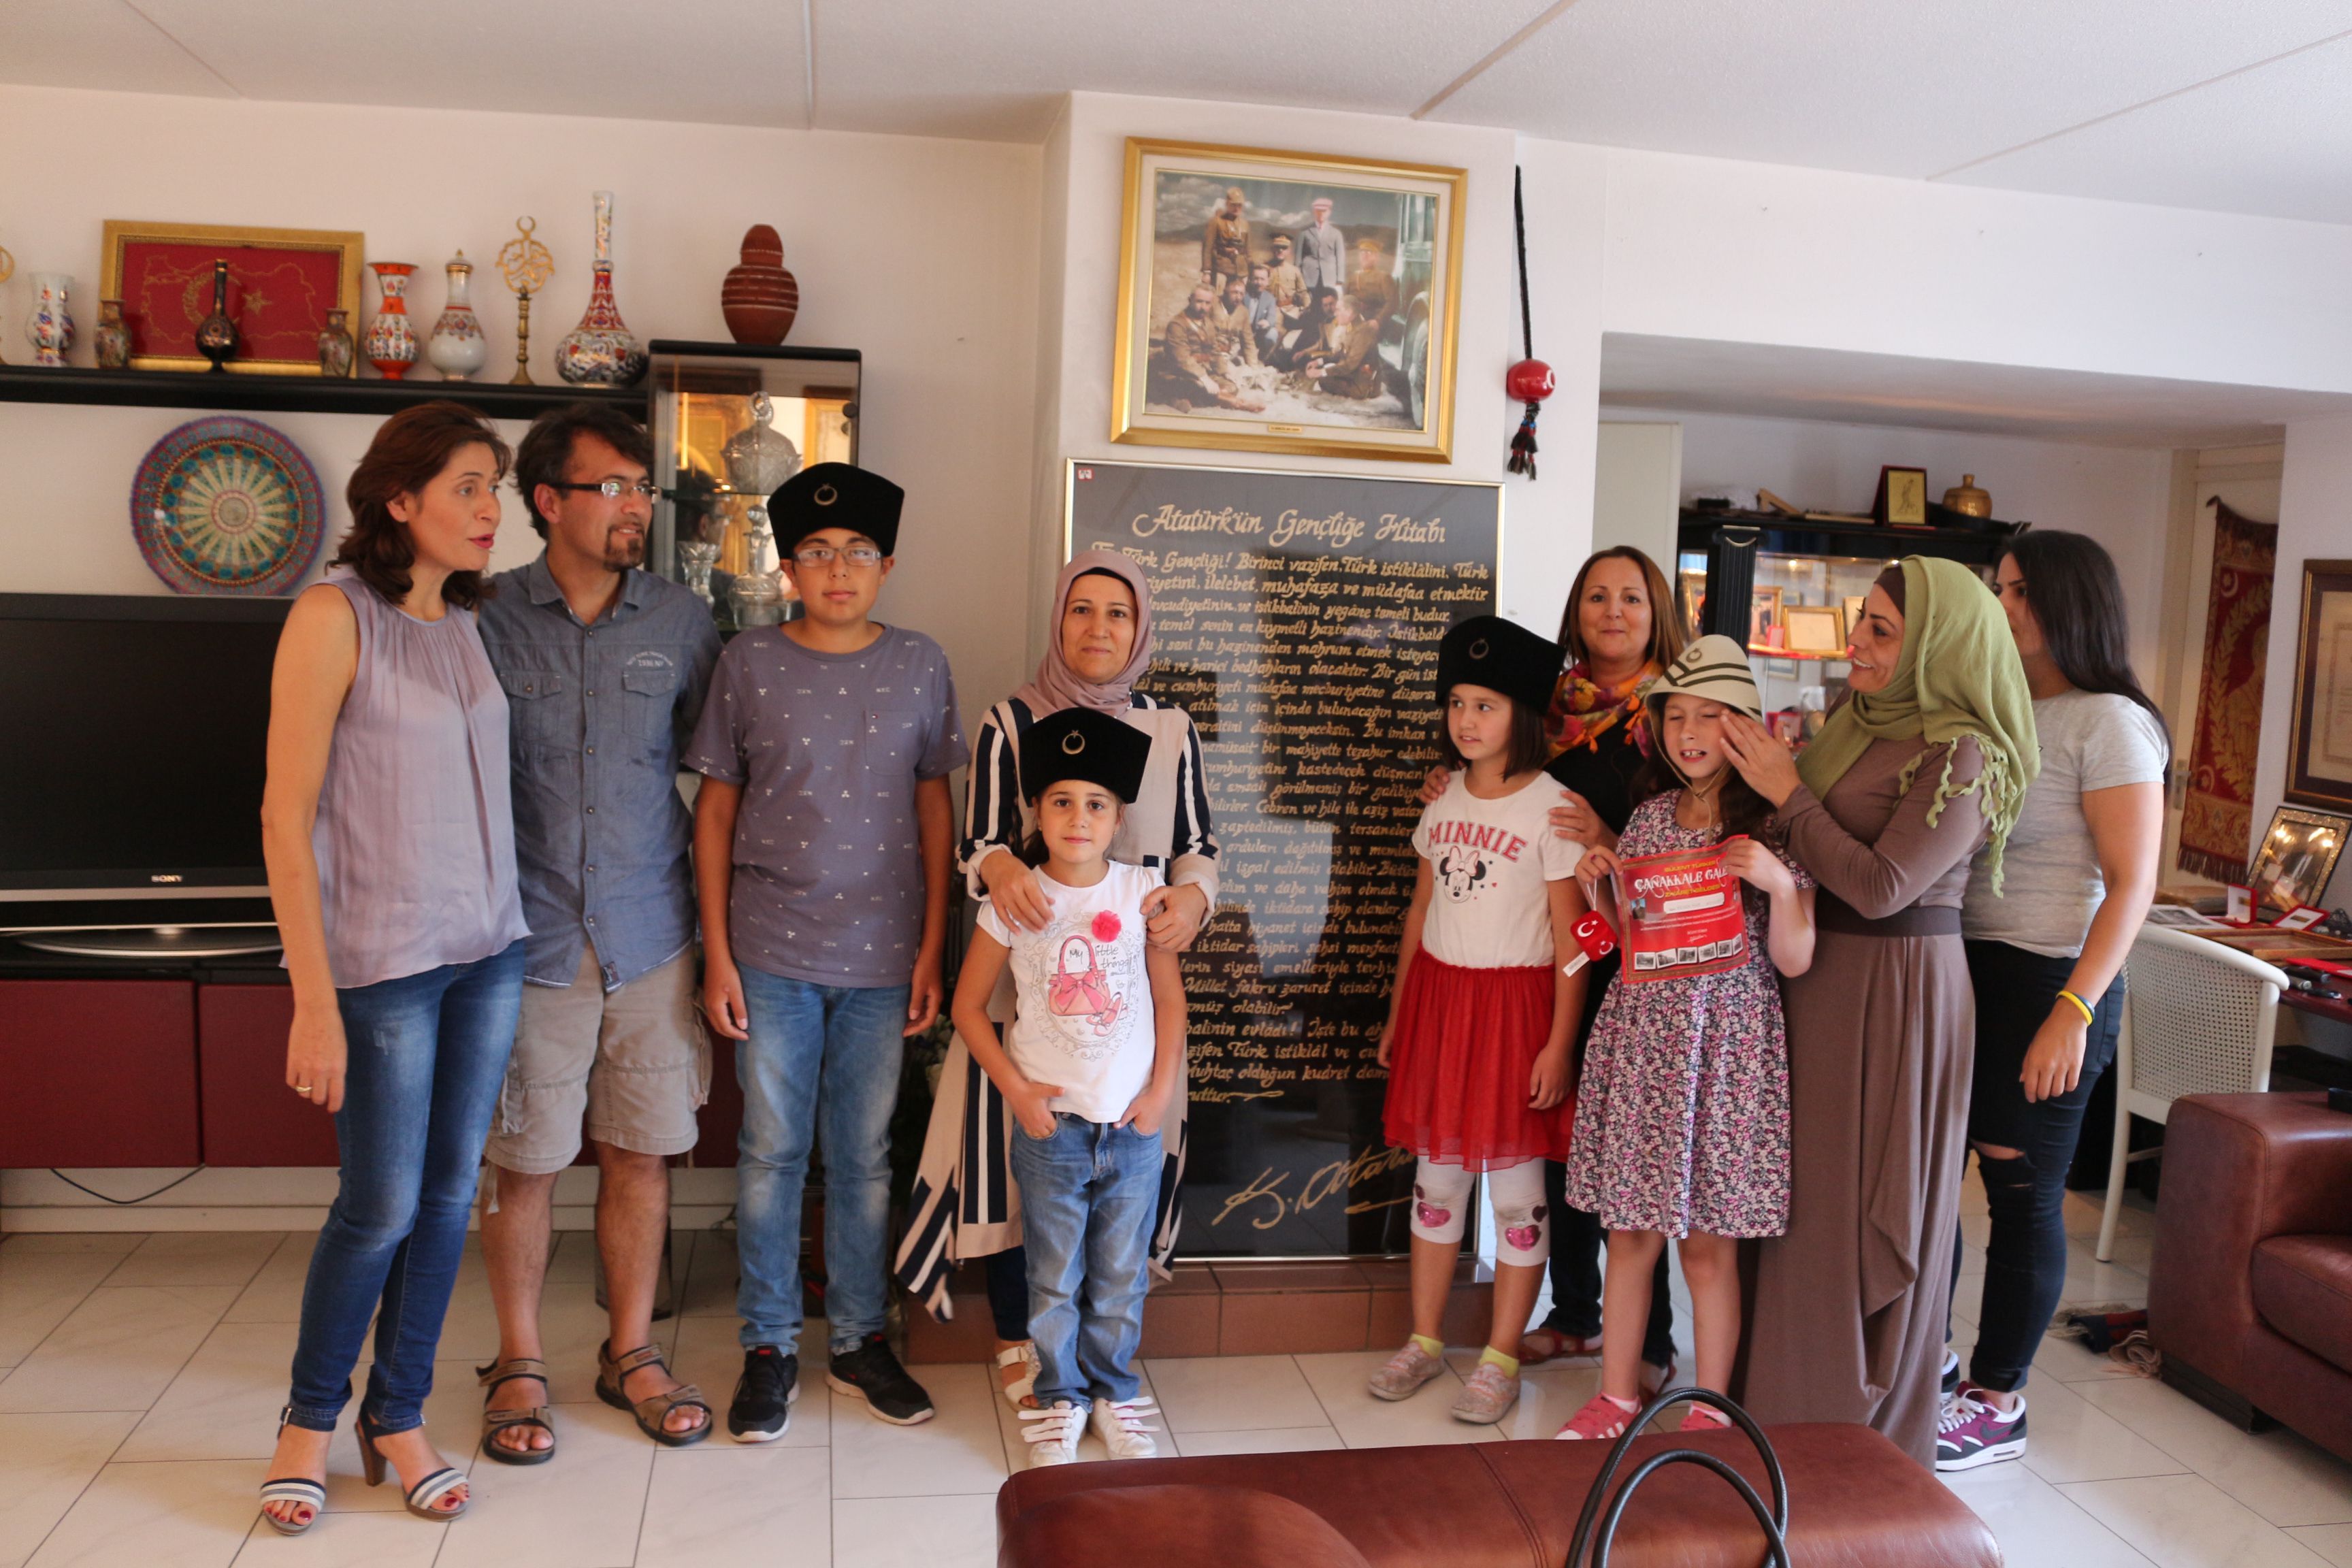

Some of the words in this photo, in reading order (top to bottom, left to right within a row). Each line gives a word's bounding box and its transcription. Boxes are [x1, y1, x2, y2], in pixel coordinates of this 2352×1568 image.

[1132, 504, 1264, 538] Atatürk'ün
[1269, 508, 1365, 549] Gençliğe
[1375, 513, 1447, 544] Hitabı
[1161, 551, 1230, 575] Gençliği!
[1235, 552, 1285, 570] Birinci
[1453, 561, 1489, 580] Türk
[1262, 576, 1339, 599] muhafaza
[1343, 584, 1360, 595] ve
[1362, 583, 1424, 604] müdafaa
[1256, 598, 1320, 616] istikbalinin
[1374, 605, 1410, 621] temeli
[1412, 607, 1450, 622] budur.
[1158, 618, 1194, 632] temel
[1200, 619, 1234, 632] senin
[1239, 623, 1253, 632] en
[1166, 638, 1193, 651] seni
[1198, 636, 1214, 651] bu
[1215, 638, 1292, 656] hazinenden
[1297, 641, 1352, 659] mahrum
[1356, 644, 1392, 659] etmek
[1174, 662, 1190, 672] ve
[1190, 657, 1228, 675] harici
[1371, 663, 1395, 680] Bir
[1395, 668, 1420, 684] gün
[1153, 682, 1166, 692] ve
[1171, 679, 1242, 698] cumhuriyeti
[1245, 680, 1298, 700] müdafaa
[1301, 683, 1386, 702] mecburiyetine
[1188, 698, 1239, 714] atılmak
[1245, 700, 1269, 715] için
[1275, 700, 1312, 716] içinde
[1317, 700, 1392, 723] bulunacağın
[1362, 723, 1384, 738] Bu
[1262, 739, 1281, 754] bir
[1286, 742, 1342, 761] mahiyette
[1269, 780, 1342, 800] görülmemiş
[1348, 781, 1370, 795] bir
[1256, 799, 1298, 815] Cebren
[1303, 804, 1317, 814] ve
[1318, 800, 1341, 818] hile
[1345, 800, 1359, 815] ile
[1349, 845, 1362, 856] ve
[1428, 819, 1528, 864] MINNIE
[151, 875, 182, 883] SONY
[1254, 884, 1269, 894] ve
[1275, 881, 1307, 898] daha
[1358, 881, 1399, 896] olmak
[1635, 870, 1703, 896] ÇANAKKALE
[1197, 938, 1245, 953] iktidar
[1222, 960, 1264, 979] siyasi
[1184, 977, 1228, 994] Millet
[1341, 1020, 1360, 1036] bu
[1226, 1041, 1269, 1059] Türk
[1334, 1047, 1351, 1059] ve
[1237, 1062, 1296, 1088] olduğun
[1301, 1064, 1352, 1081] kudret
